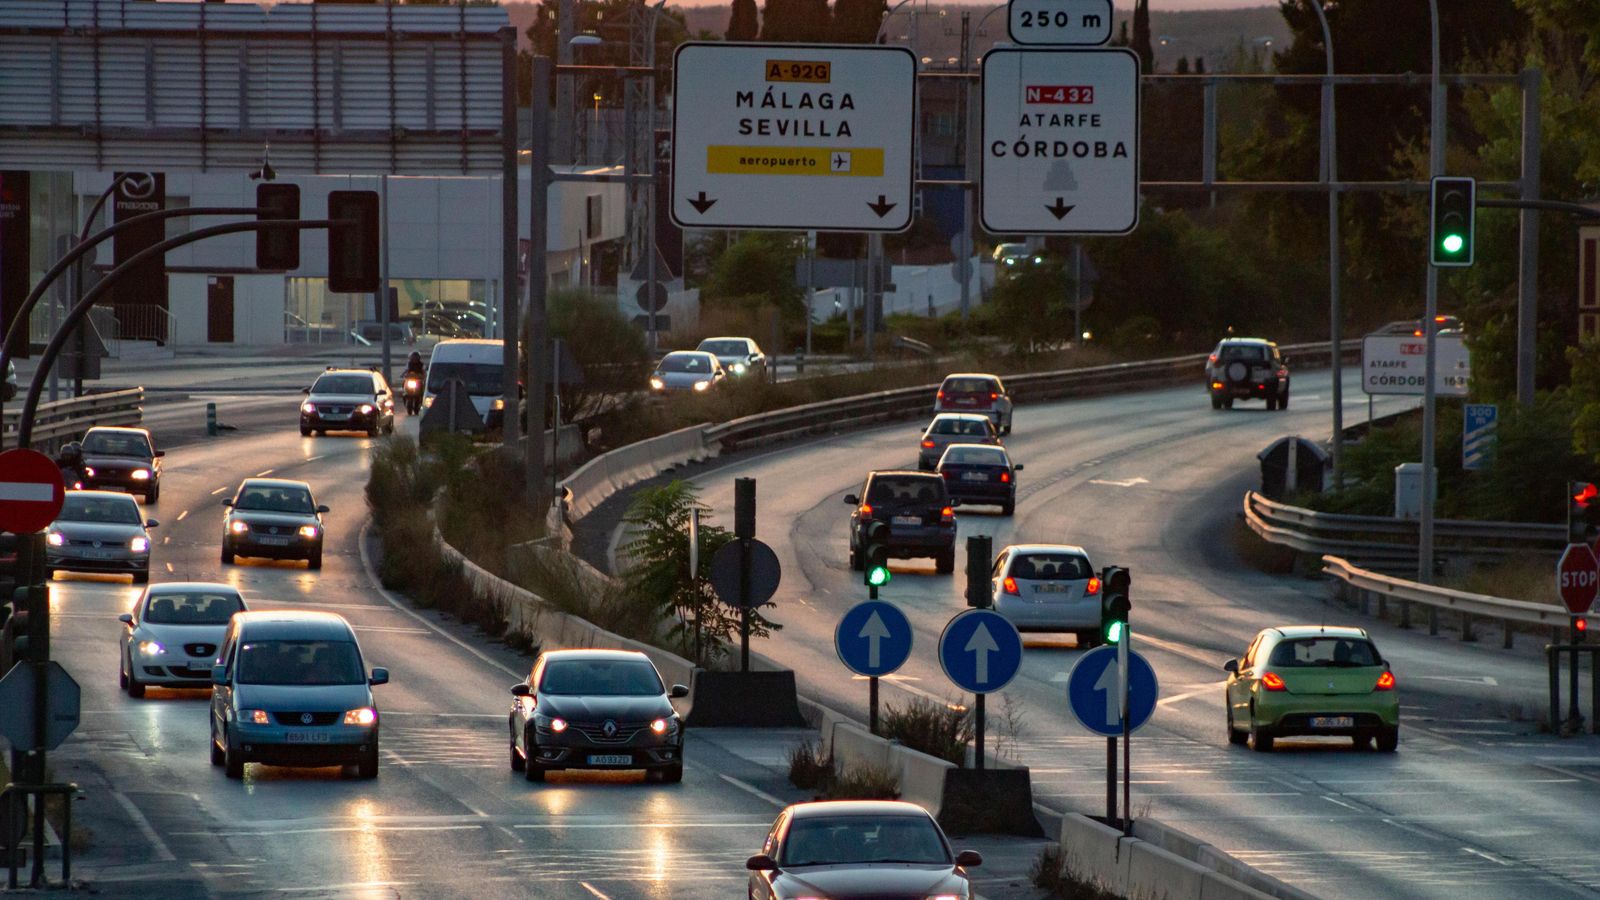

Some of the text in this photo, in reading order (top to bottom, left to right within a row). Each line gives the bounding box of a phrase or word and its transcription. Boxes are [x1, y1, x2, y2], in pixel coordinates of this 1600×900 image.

[1021, 11, 1101, 28] 250 m
[769, 64, 828, 79] A-92G
[736, 85, 855, 110] MÁLAGA
[1027, 88, 1093, 102] N-432
[1019, 113, 1101, 127] ATARFE
[738, 118, 852, 137] SEVILLA
[991, 134, 1128, 158] CÓRDOBA
[739, 154, 816, 167] aeropuerto
[116, 201, 159, 210] mazda
[1370, 360, 1407, 369] ATARFE
[1369, 372, 1425, 386] CÓRDOB
[1470, 406, 1492, 417] 300
[1562, 571, 1597, 588] STOP
